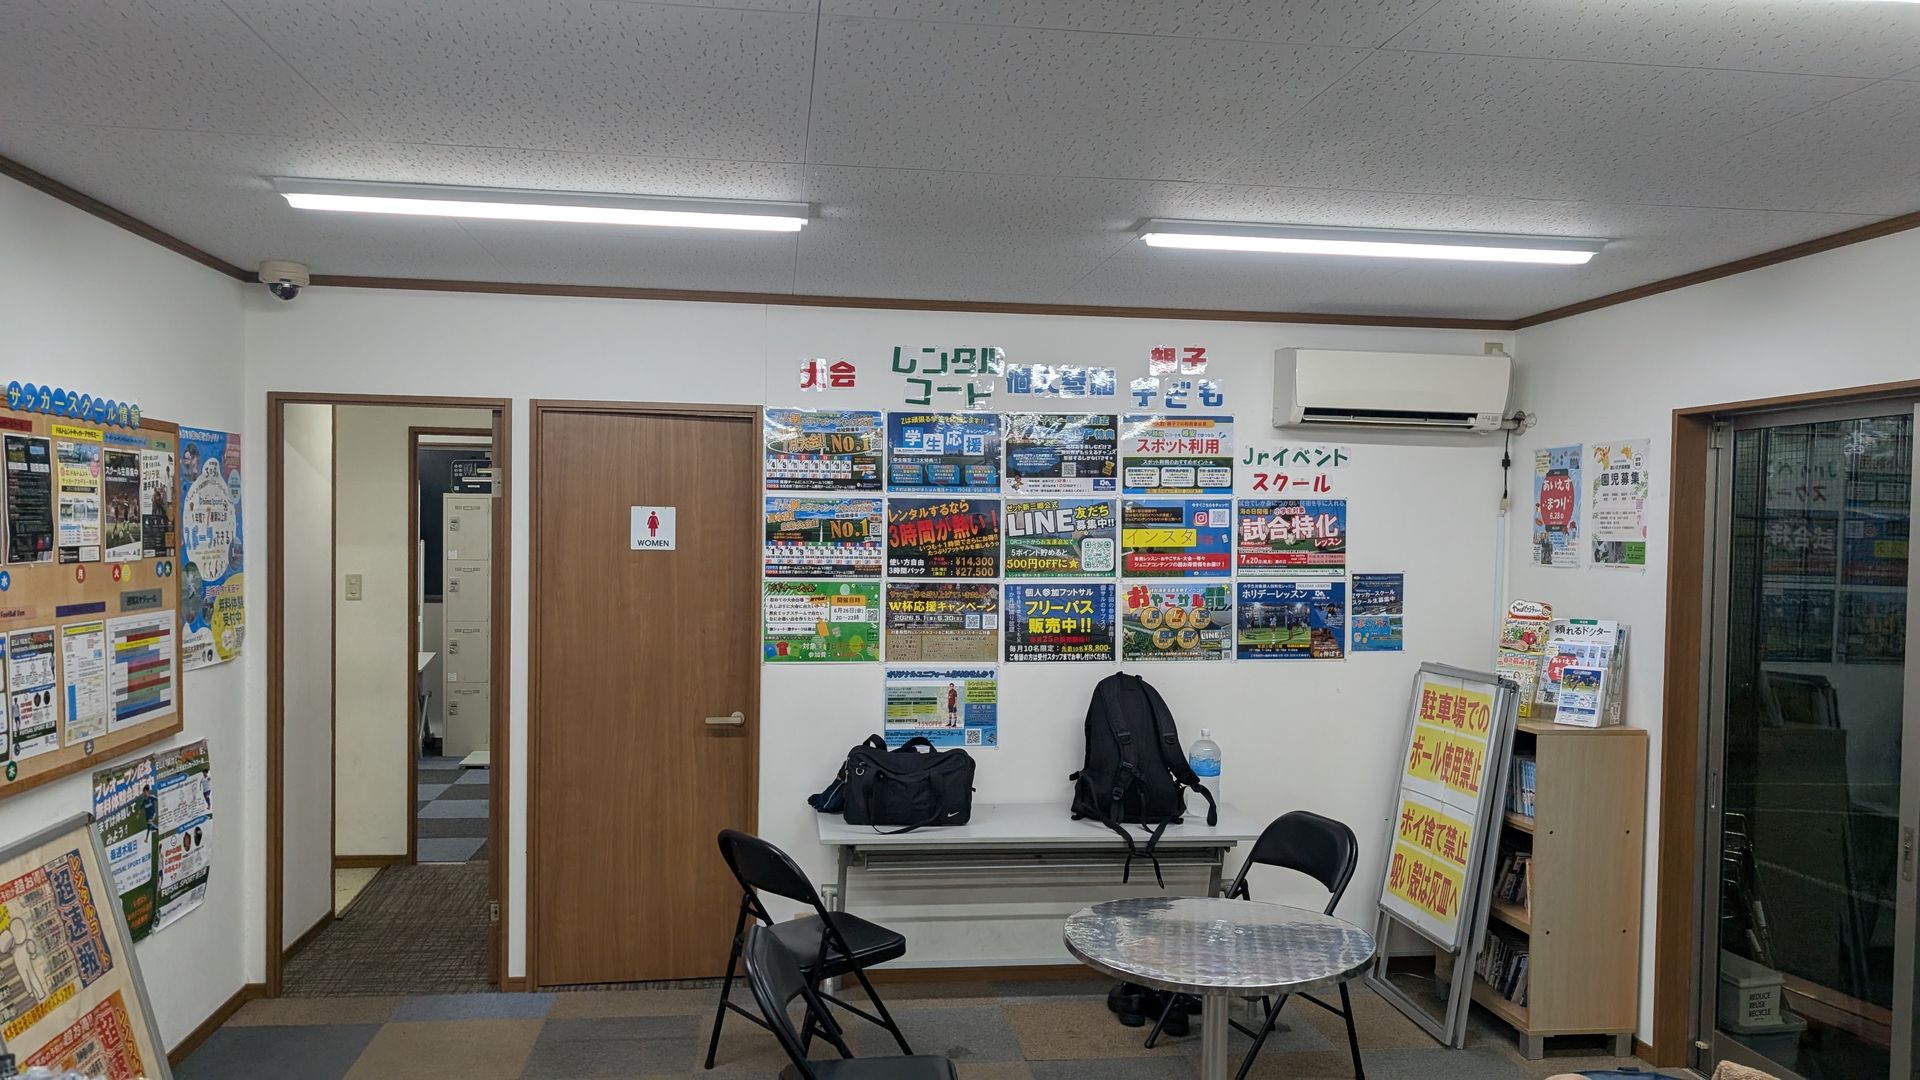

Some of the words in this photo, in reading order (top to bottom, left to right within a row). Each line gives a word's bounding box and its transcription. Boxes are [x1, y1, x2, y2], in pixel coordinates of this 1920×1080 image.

[892, 346, 1002, 375] レンタル
[800, 360, 856, 389] 大会
[905, 378, 992, 406] コート
[1132, 381, 1223, 408] 子ども
[9, 386, 140, 425] サッカースクール情報
[905, 429, 982, 453] 学生応援
[1136, 439, 1219, 454] スポット利用
[1242, 447, 1348, 467] Jrイベント
[1252, 473, 1331, 493] スクール
[1543, 479, 1572, 491] あいえす
[1601, 471, 1640, 486] 園児募集
[1547, 496, 1566, 510] まつり
[888, 500, 969, 523] レンタルするなら
[1075, 505, 1109, 519] 友だち
[830, 518, 869, 539] NO.1
[1007, 508, 1075, 537] LINE
[1076, 519, 1115, 531] 募集中!!
[1242, 514, 1339, 542] 試合特化
[637, 539, 669, 547] WOMEN
[1126, 529, 1193, 545] インスタ
[1314, 538, 1342, 547] レッスン
[1011, 549, 1068, 557] 5ポイント貯めると
[889, 558, 925, 566] 使い方自由
[888, 567, 926, 575] 3時間パック
[1025, 588, 1094, 597] 個人参加フットサル
[1127, 585, 1204, 608] おやこサル
[1242, 589, 1308, 599] ホリデーレッスン
[889, 600, 997, 612] W杯応援キャンペーン
[1025, 600, 1094, 615] フリーパス
[1028, 617, 1091, 634] 販売中!!
[1554, 625, 1611, 636] 頼れるドクター
[1419, 688, 1490, 733] 駐車場での
[1409, 734, 1482, 792] ボール使用禁止
[1400, 808, 1468, 866] ポイ捨て禁止
[161, 881, 179, 897] FUTSAL
[1389, 852, 1458, 919] 吸い殻は灰皿へ
[53, 868, 101, 978] 超速報
[1750, 992, 1771, 1000] REDUCE
[1749, 1008, 1771, 1017] RECYCLE
